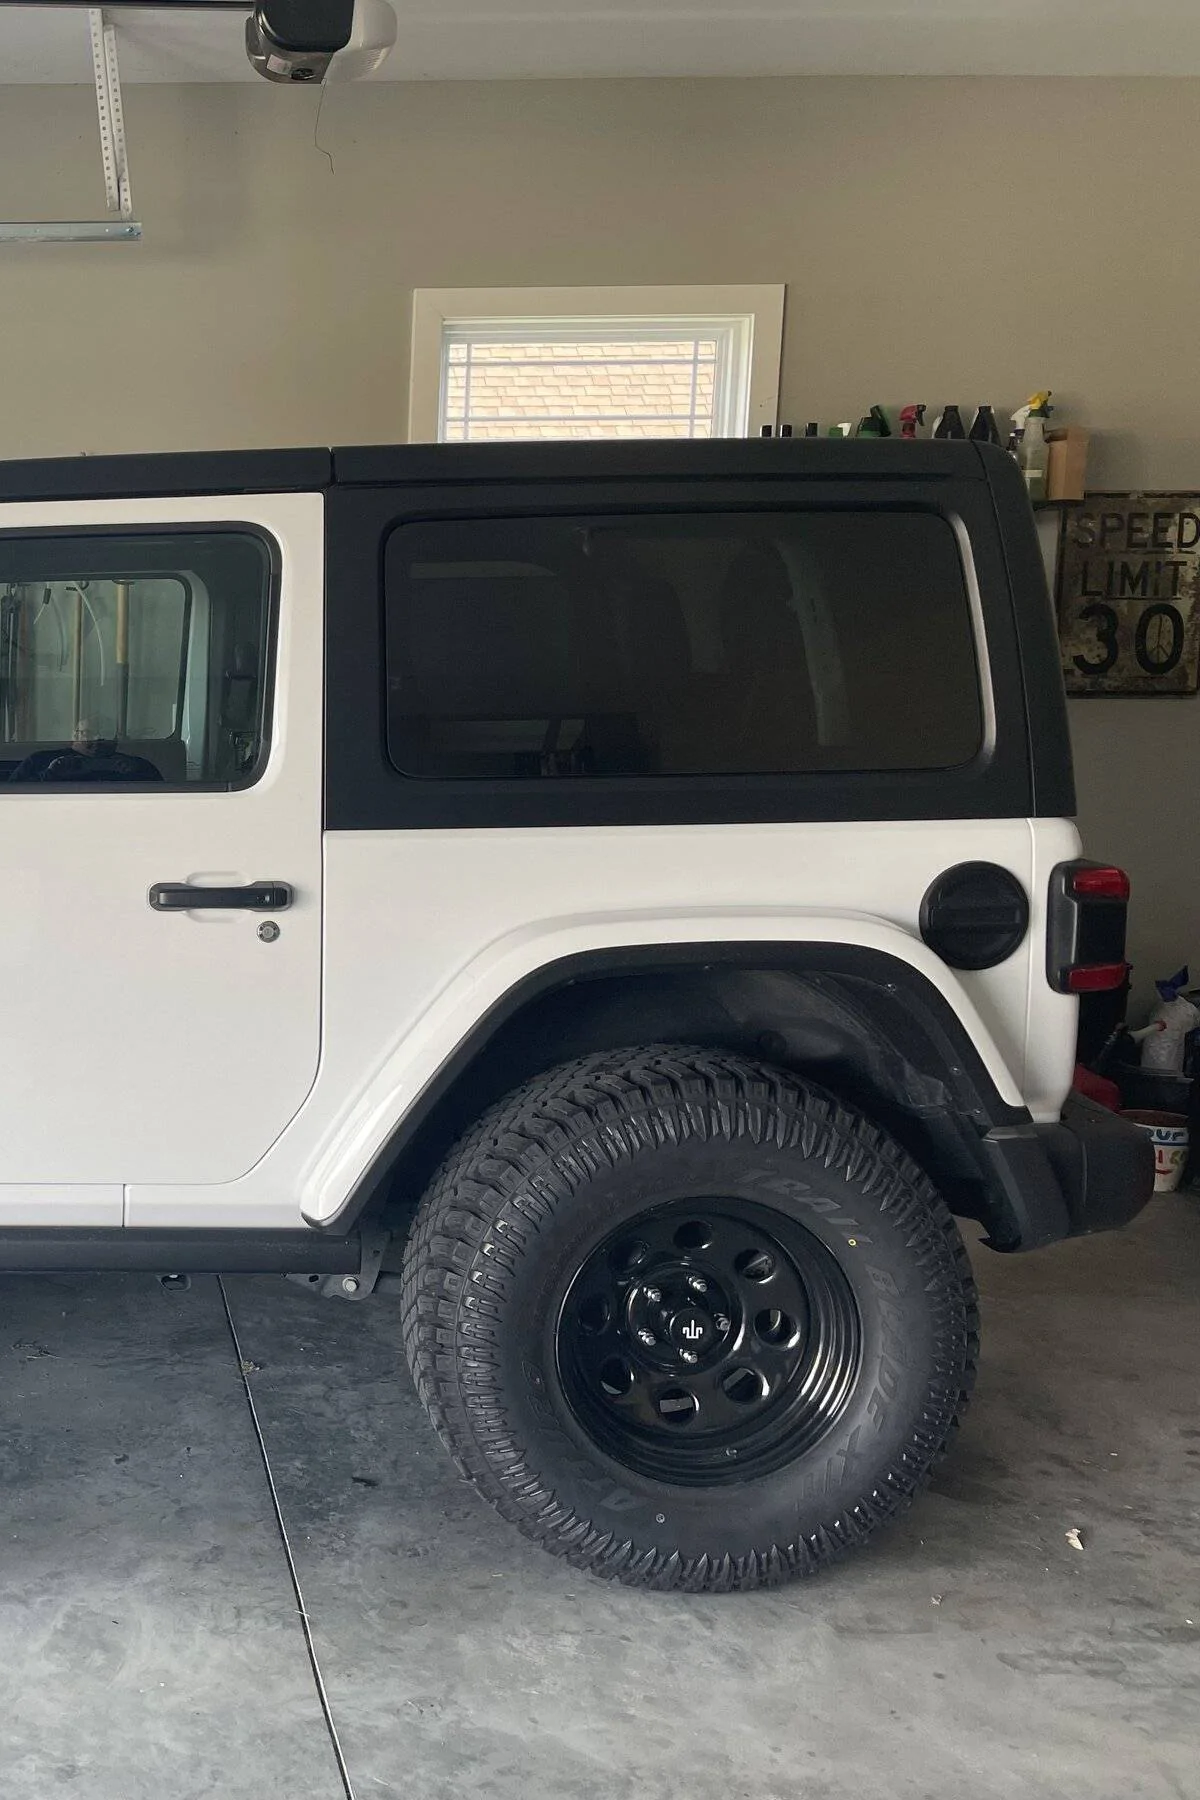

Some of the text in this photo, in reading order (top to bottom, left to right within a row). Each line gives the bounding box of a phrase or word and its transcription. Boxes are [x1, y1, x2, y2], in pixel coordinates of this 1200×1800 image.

[1073, 512, 1200, 549] SPEED
[1081, 560, 1188, 597] LIMIT
[1072, 603, 1185, 675] 30
